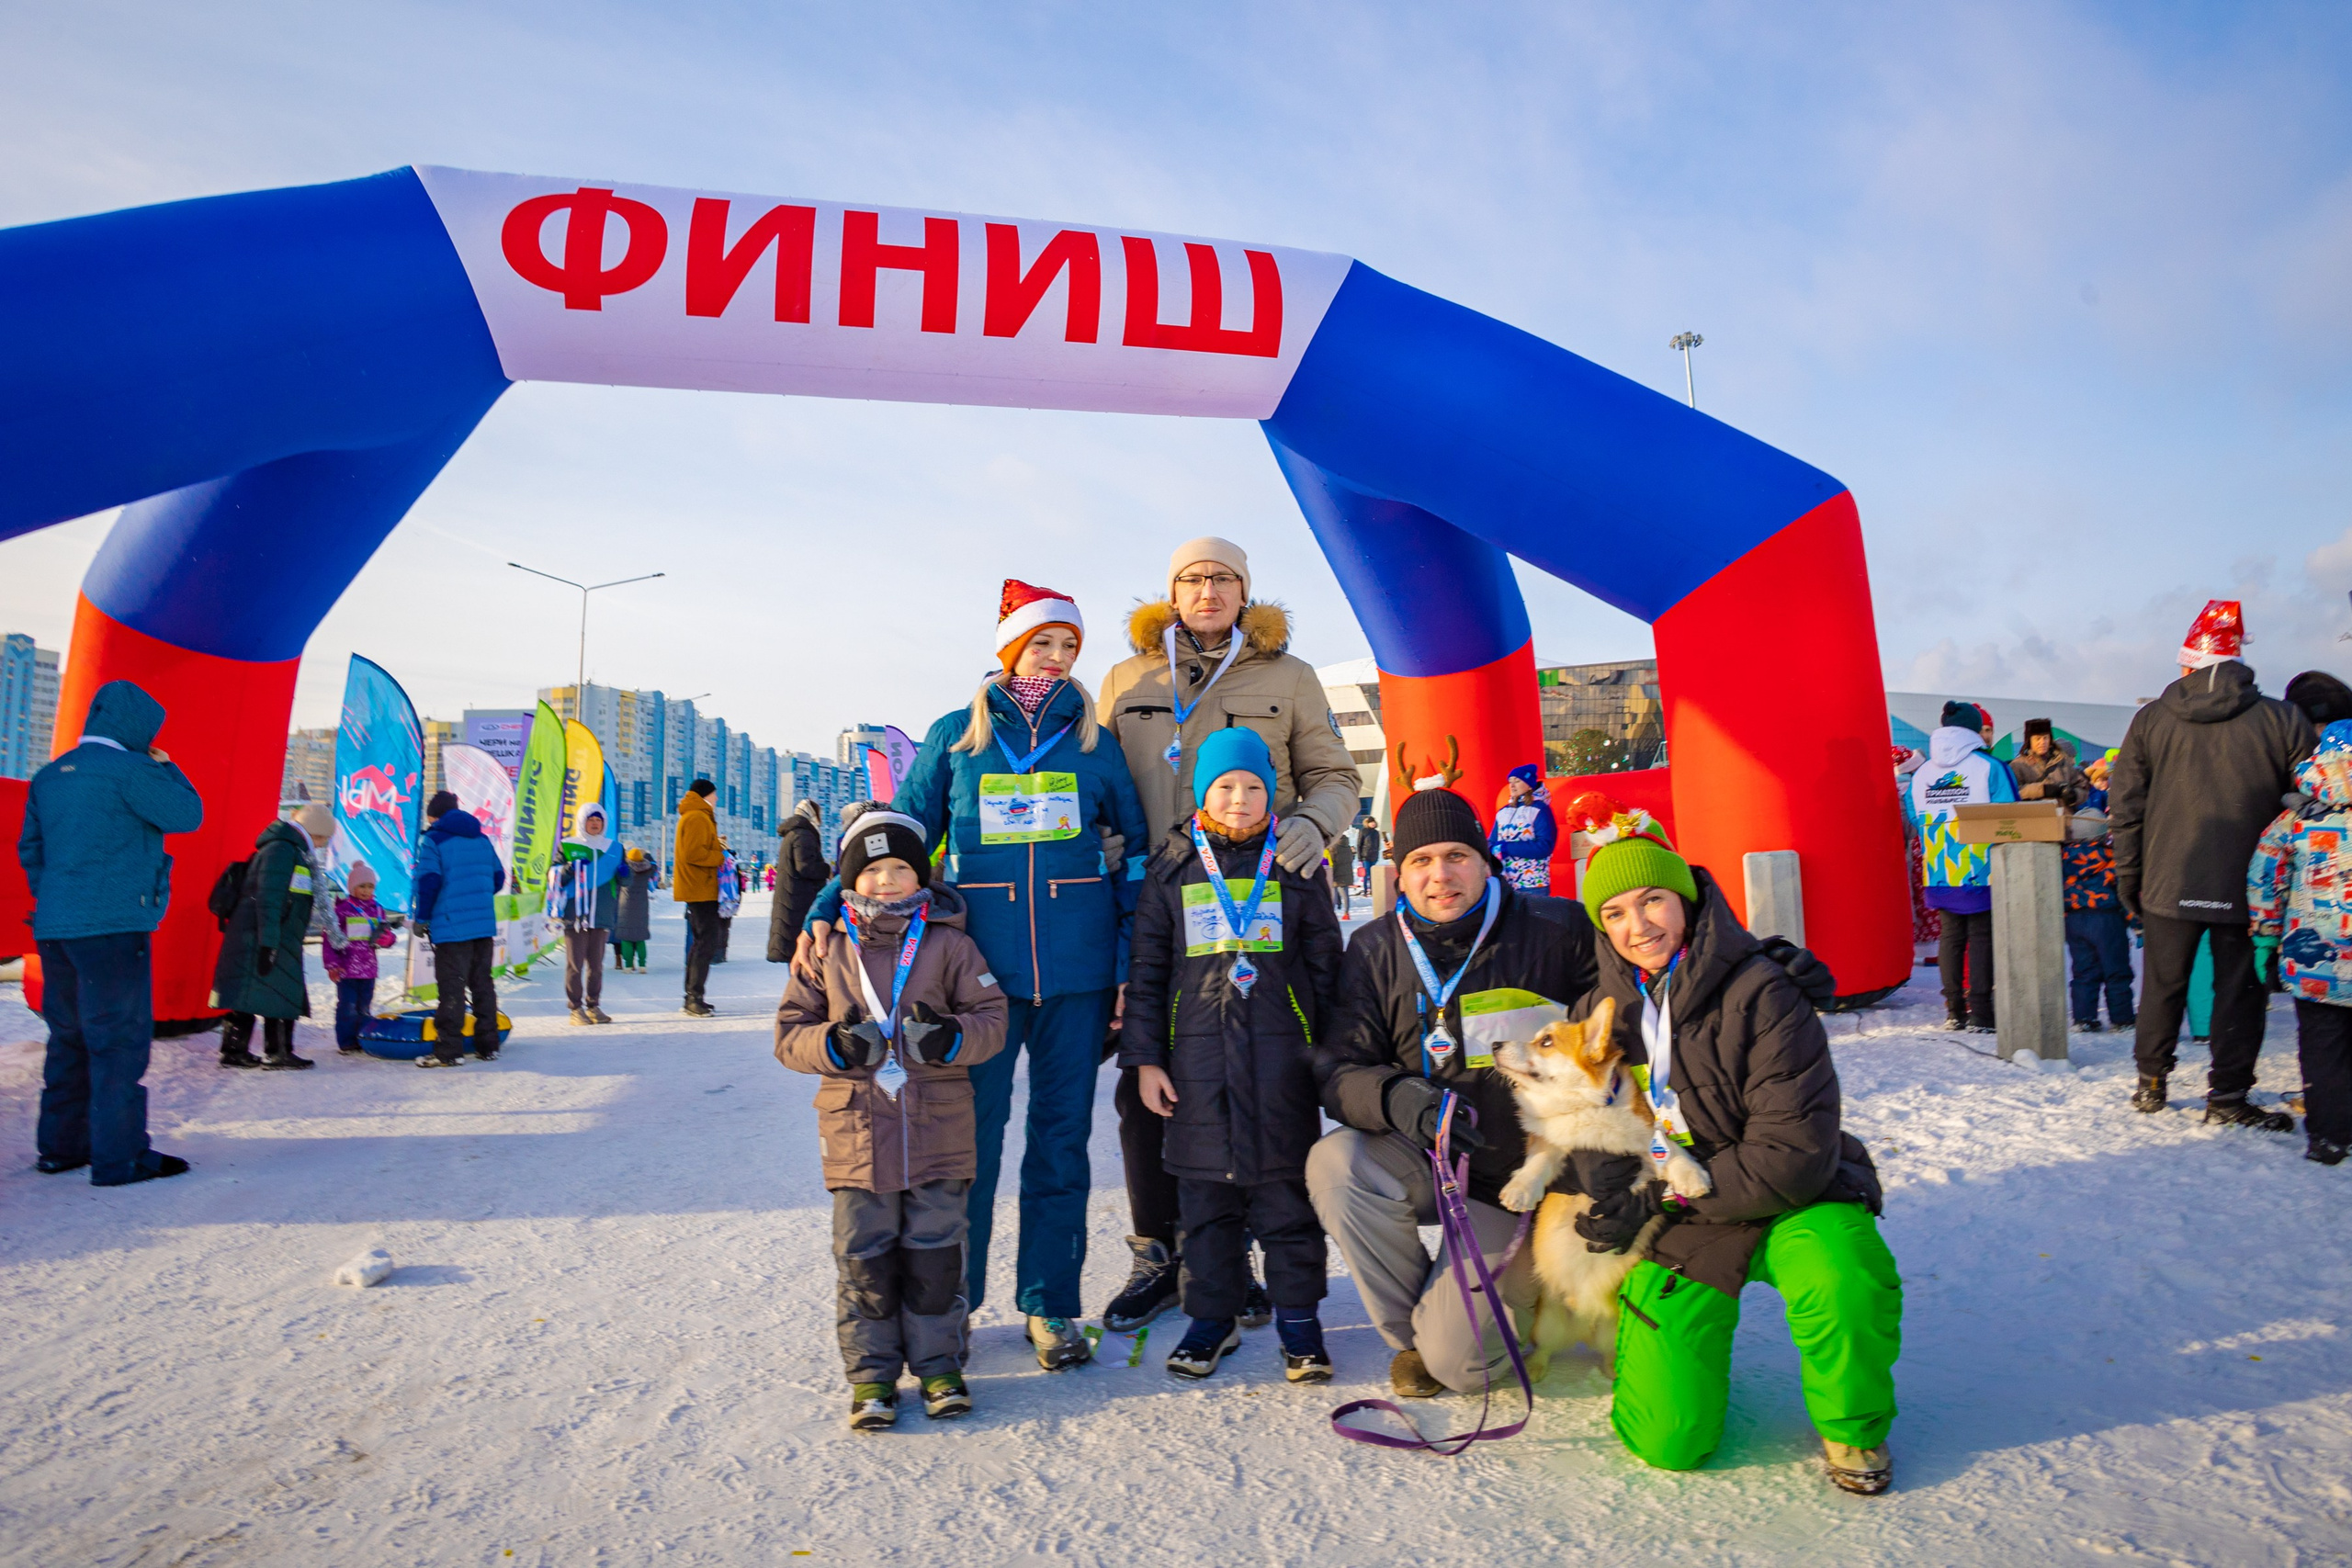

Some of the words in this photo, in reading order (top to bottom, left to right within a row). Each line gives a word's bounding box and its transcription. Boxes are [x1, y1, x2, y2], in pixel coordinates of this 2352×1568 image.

[501, 186, 1283, 358] ФИНИШ
[1201, 847, 1217, 875] 2024
[1259, 847, 1273, 876] 2024
[2178, 899, 2233, 910] NORDSKI
[900, 938, 919, 967] 2024
